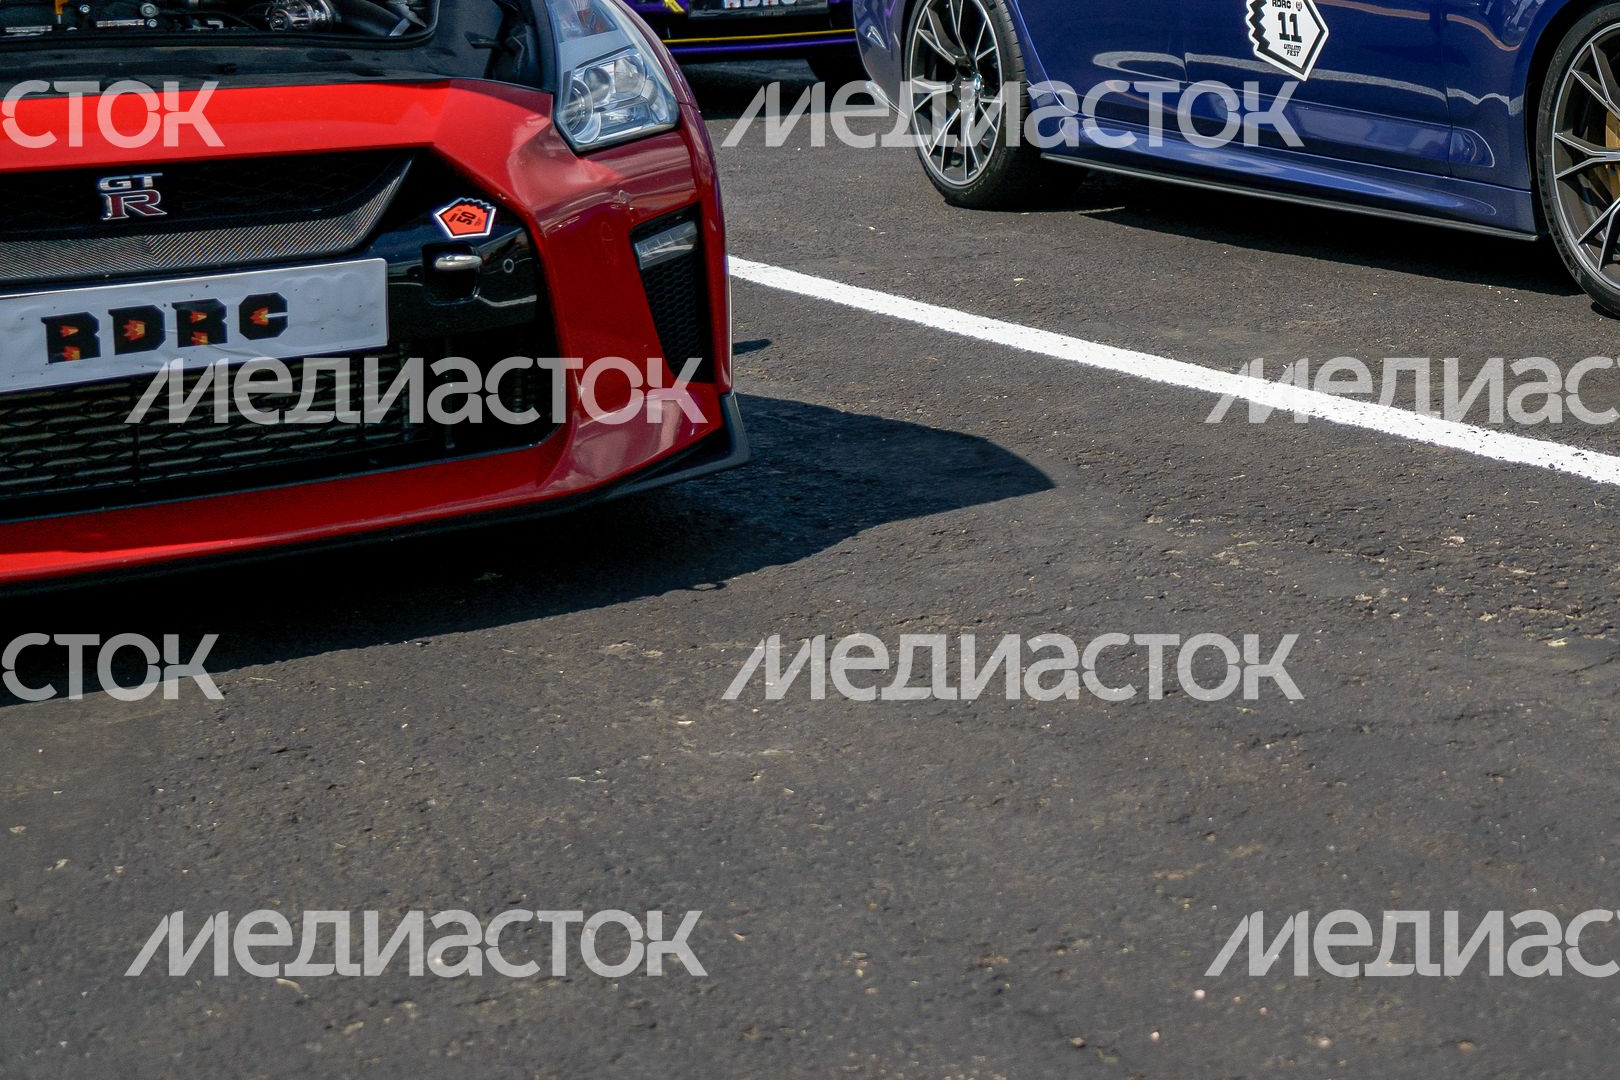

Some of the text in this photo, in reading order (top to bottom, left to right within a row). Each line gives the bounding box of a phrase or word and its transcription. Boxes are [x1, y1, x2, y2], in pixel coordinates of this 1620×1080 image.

[1277, 11, 1303, 43] 11
[1286, 49, 1301, 57] FEST
[99, 172, 164, 191] GT
[40, 291, 289, 364] RDRC
